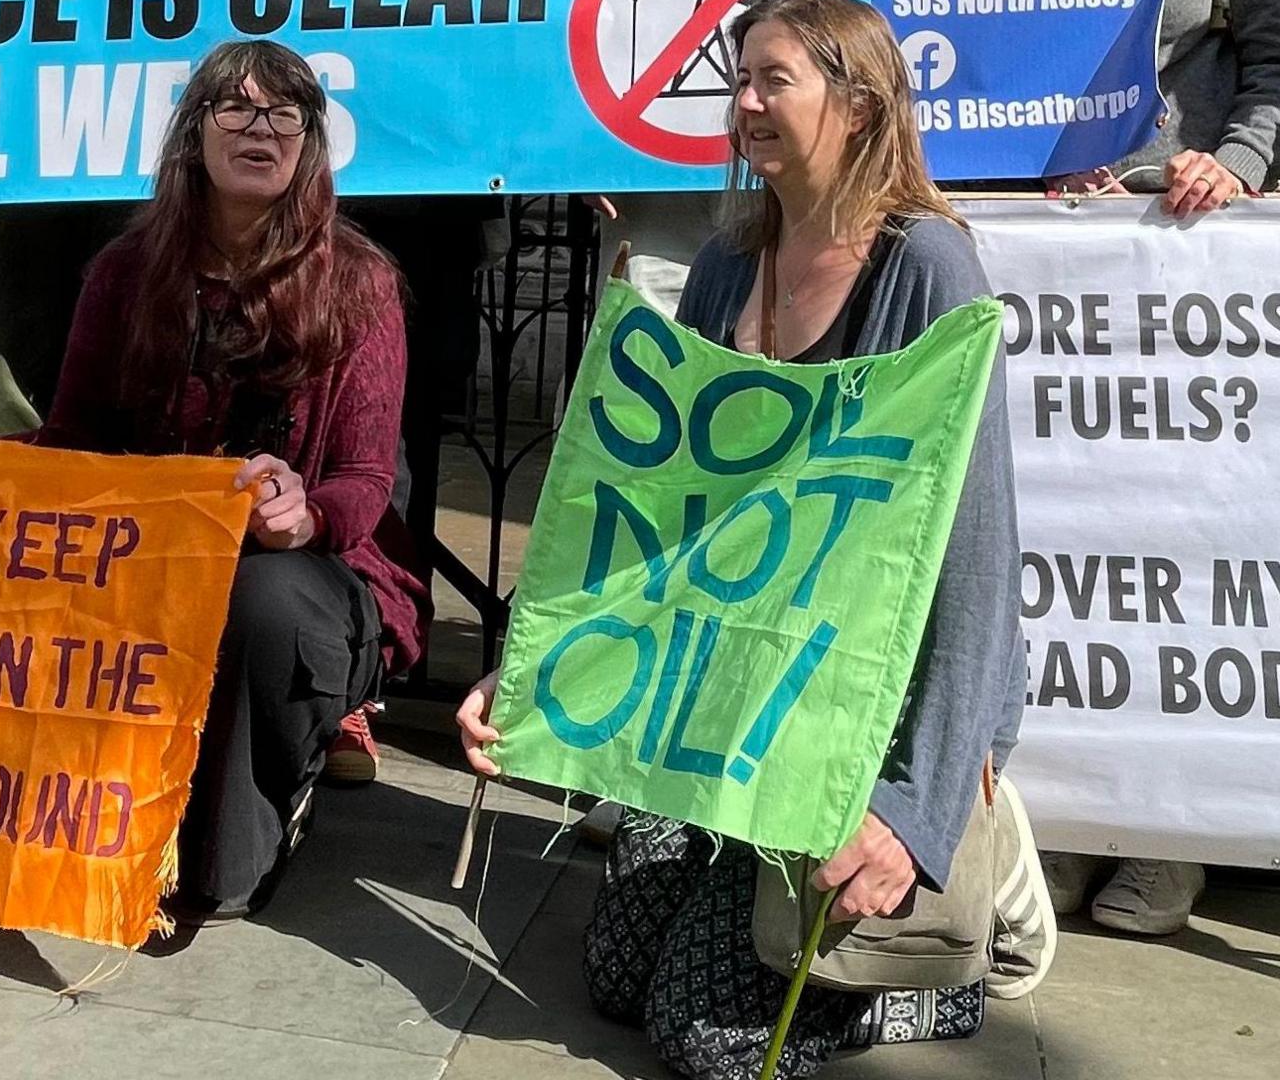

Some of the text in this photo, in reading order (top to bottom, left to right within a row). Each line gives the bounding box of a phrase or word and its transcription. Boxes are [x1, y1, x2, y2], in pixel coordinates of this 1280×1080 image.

[914, 83, 1141, 133] OS Biscathorpe
[1003, 291, 1112, 357] ORE
[1033, 375, 1259, 444] FUELS?
[582, 473, 895, 611] NOT
[1020, 552, 1187, 625] OVER
[50, 637, 169, 716] THE
[533, 607, 840, 787] OIL!
